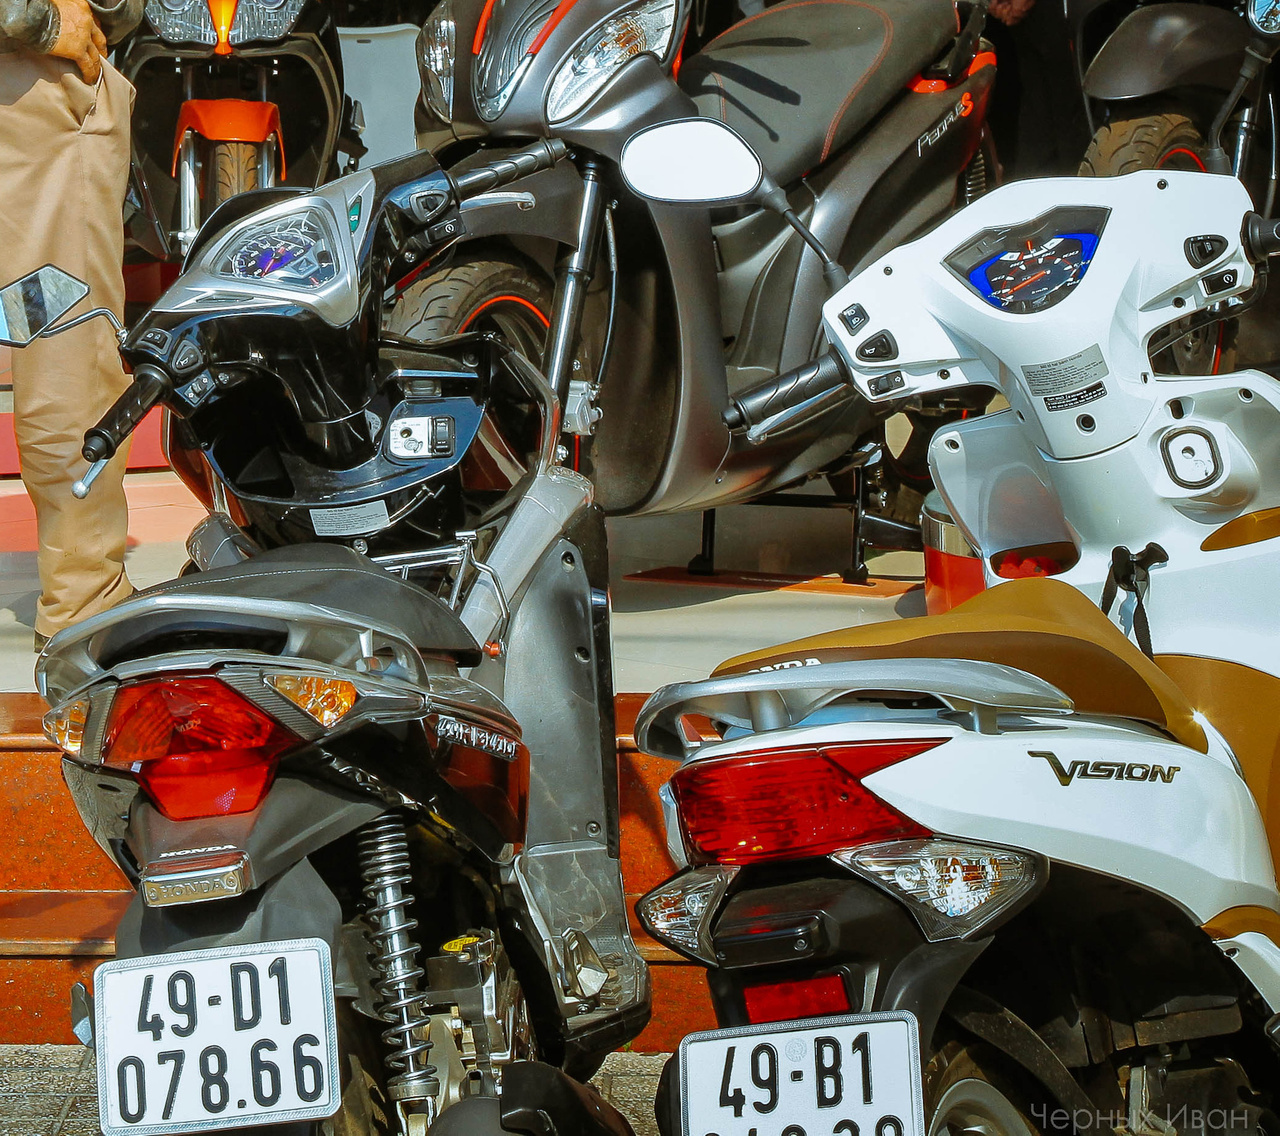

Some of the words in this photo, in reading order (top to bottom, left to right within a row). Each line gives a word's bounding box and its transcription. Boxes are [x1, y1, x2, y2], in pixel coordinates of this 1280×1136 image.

[1027, 750, 1182, 787] VISION
[159, 844, 238, 859] HONDA
[159, 878, 229, 899] HONDA
[136, 956, 292, 1042] 49-D1
[116, 1033, 326, 1125] 078.66
[718, 1031, 875, 1119] 49-B1
